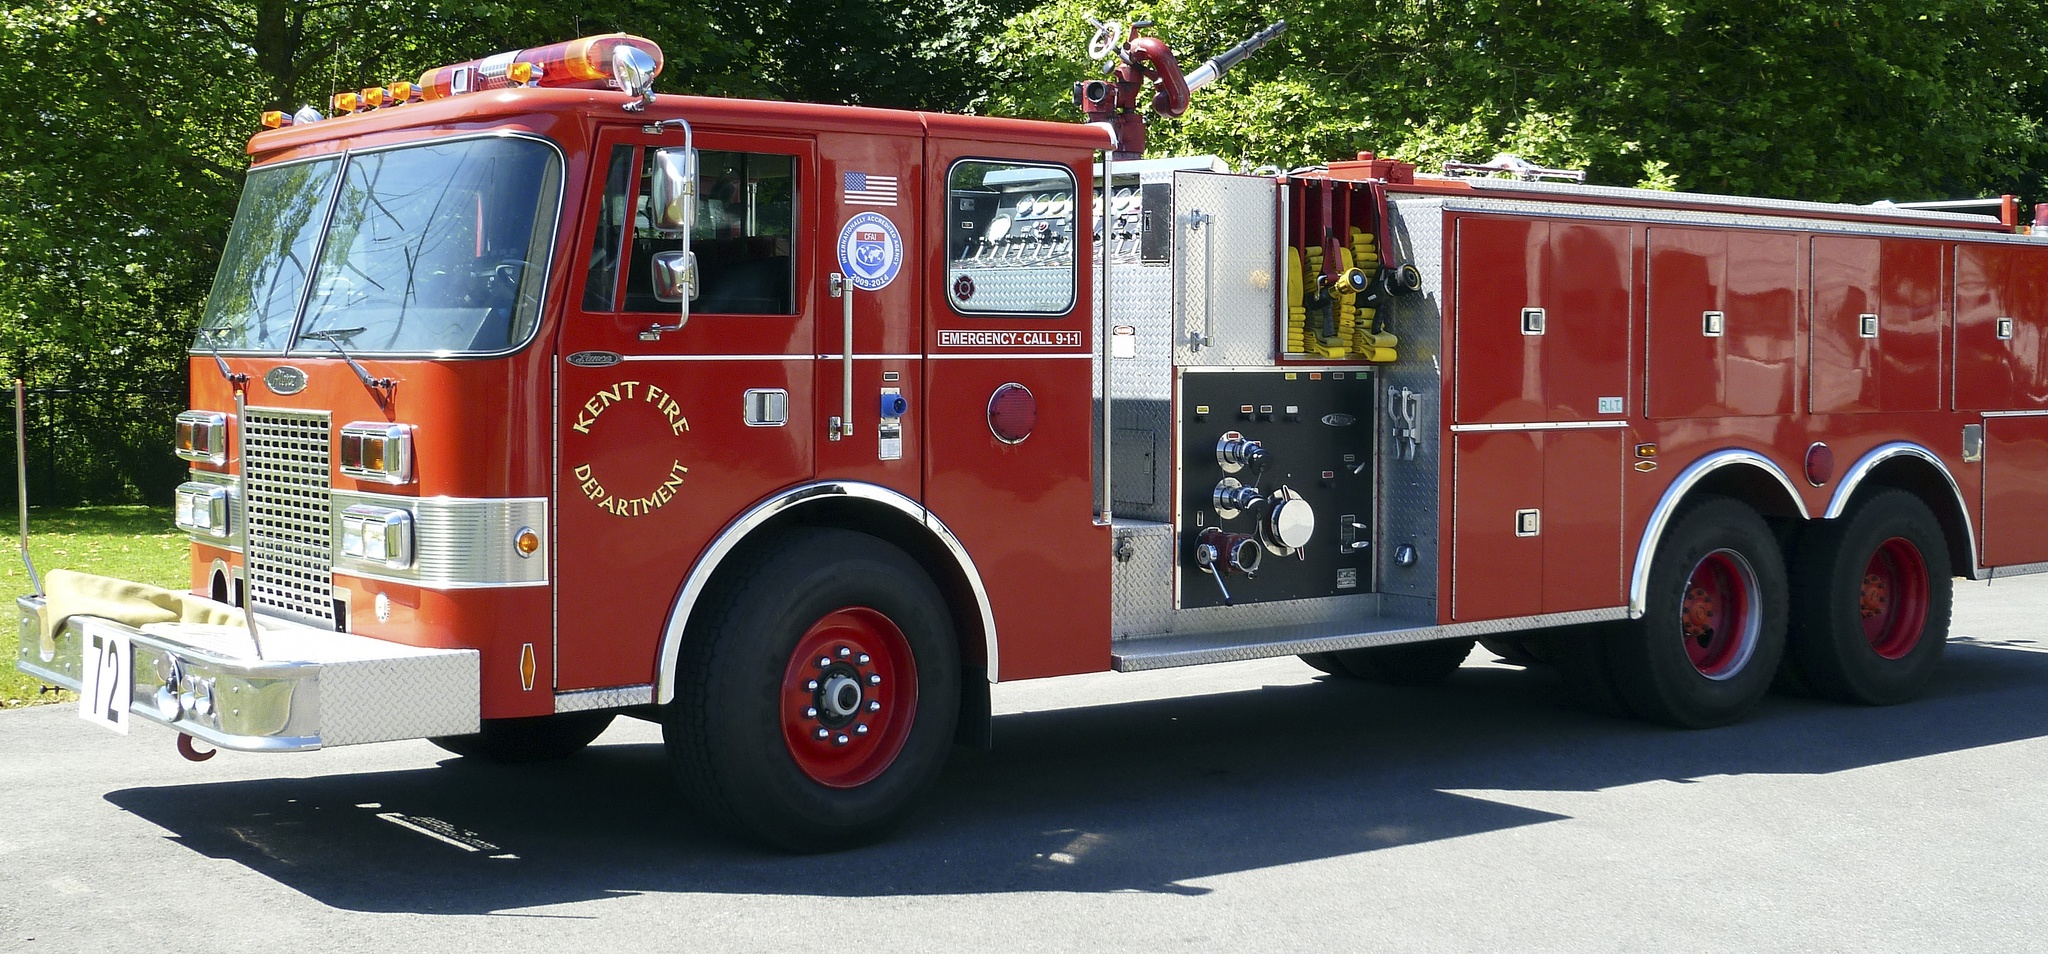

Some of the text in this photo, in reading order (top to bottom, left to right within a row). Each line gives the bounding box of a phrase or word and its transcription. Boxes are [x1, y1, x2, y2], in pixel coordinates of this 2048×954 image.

[841, 216, 866, 264] INTERNATIONALLY
[867, 216, 897, 239] ACCREDITED
[864, 232, 877, 241] CFAI
[851, 273, 889, 287] 2009-2014
[573, 381, 690, 437] KENT FIRE
[574, 459, 688, 517] DEPARTMENT
[92, 634, 119, 724] 72
